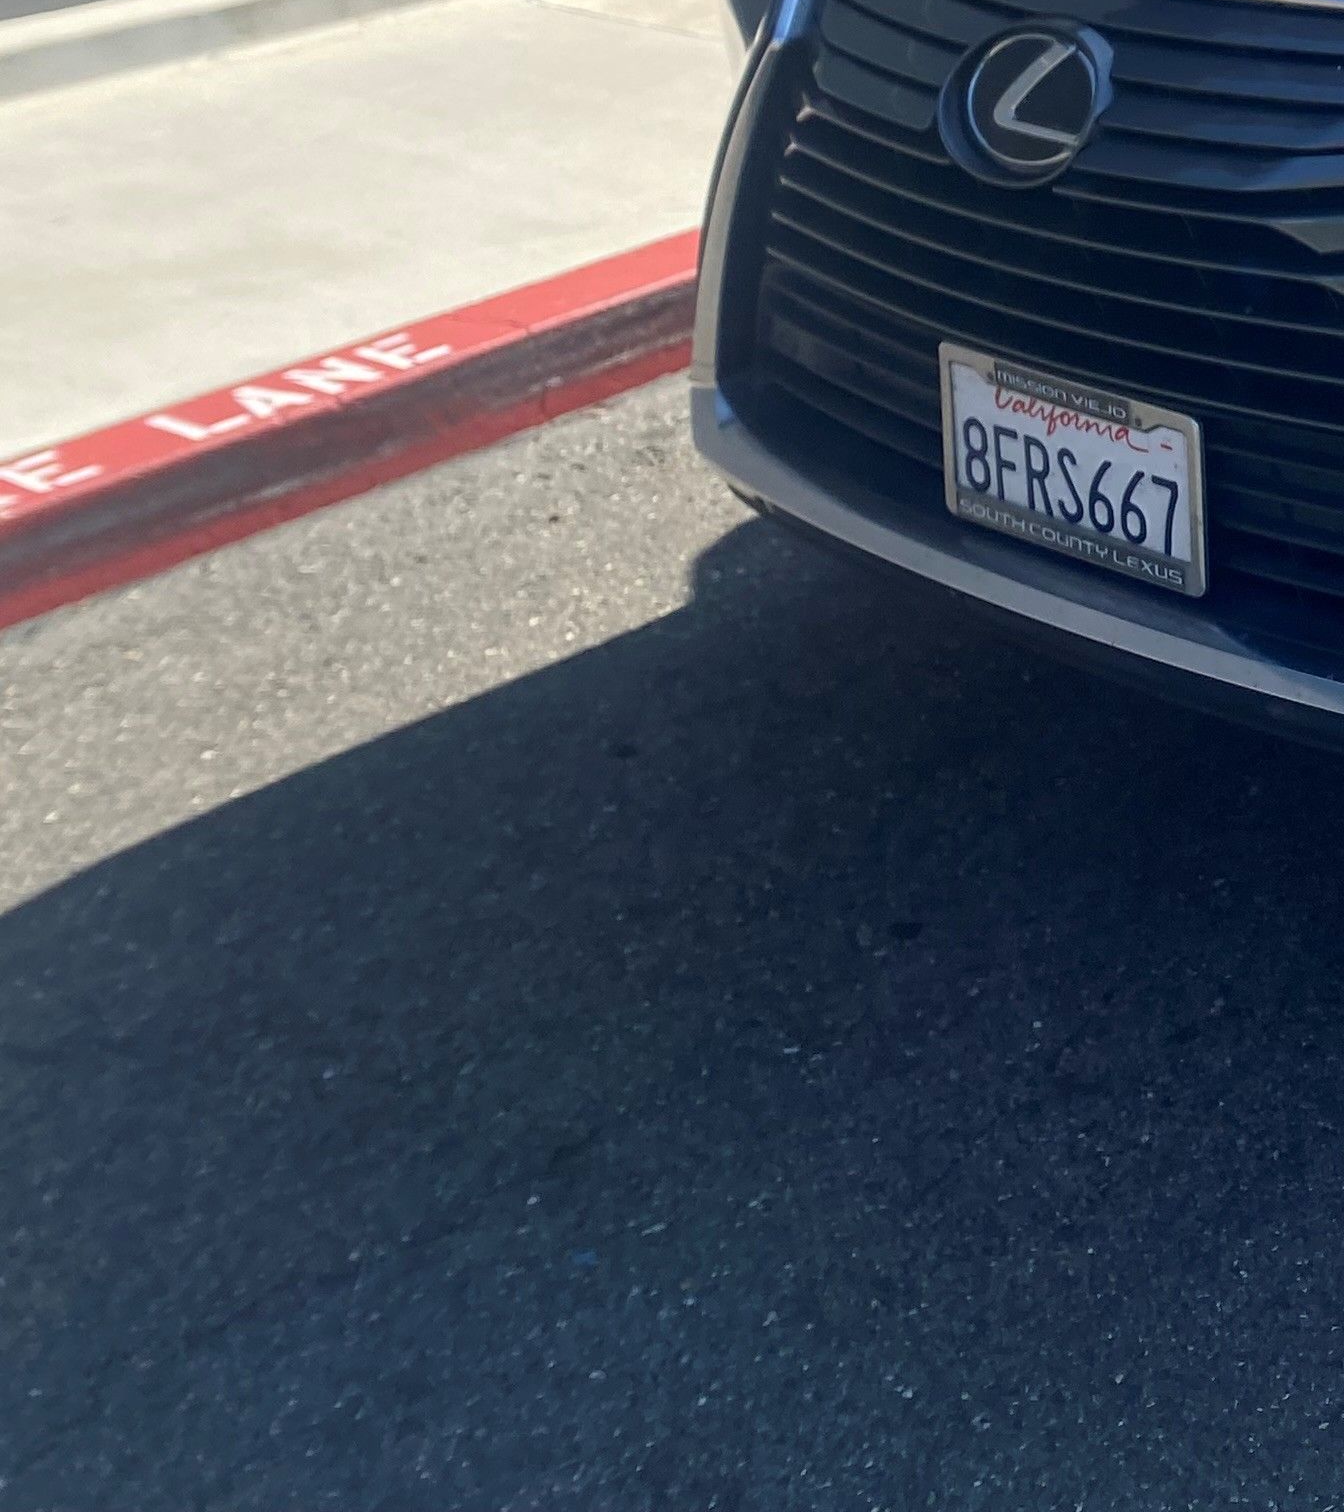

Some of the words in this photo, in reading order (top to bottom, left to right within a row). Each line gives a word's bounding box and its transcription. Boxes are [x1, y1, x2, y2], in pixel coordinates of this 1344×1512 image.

[146, 332, 453, 441] LANE
[994, 388, 1149, 453] California
[1070, 394, 1127, 418] VIEJO
[963, 417, 1179, 556] 8FRS667
[960, 499, 1026, 533] SOUTH
[1031, 523, 1108, 557] COUNTY
[1113, 550, 1184, 585] LEXUS
